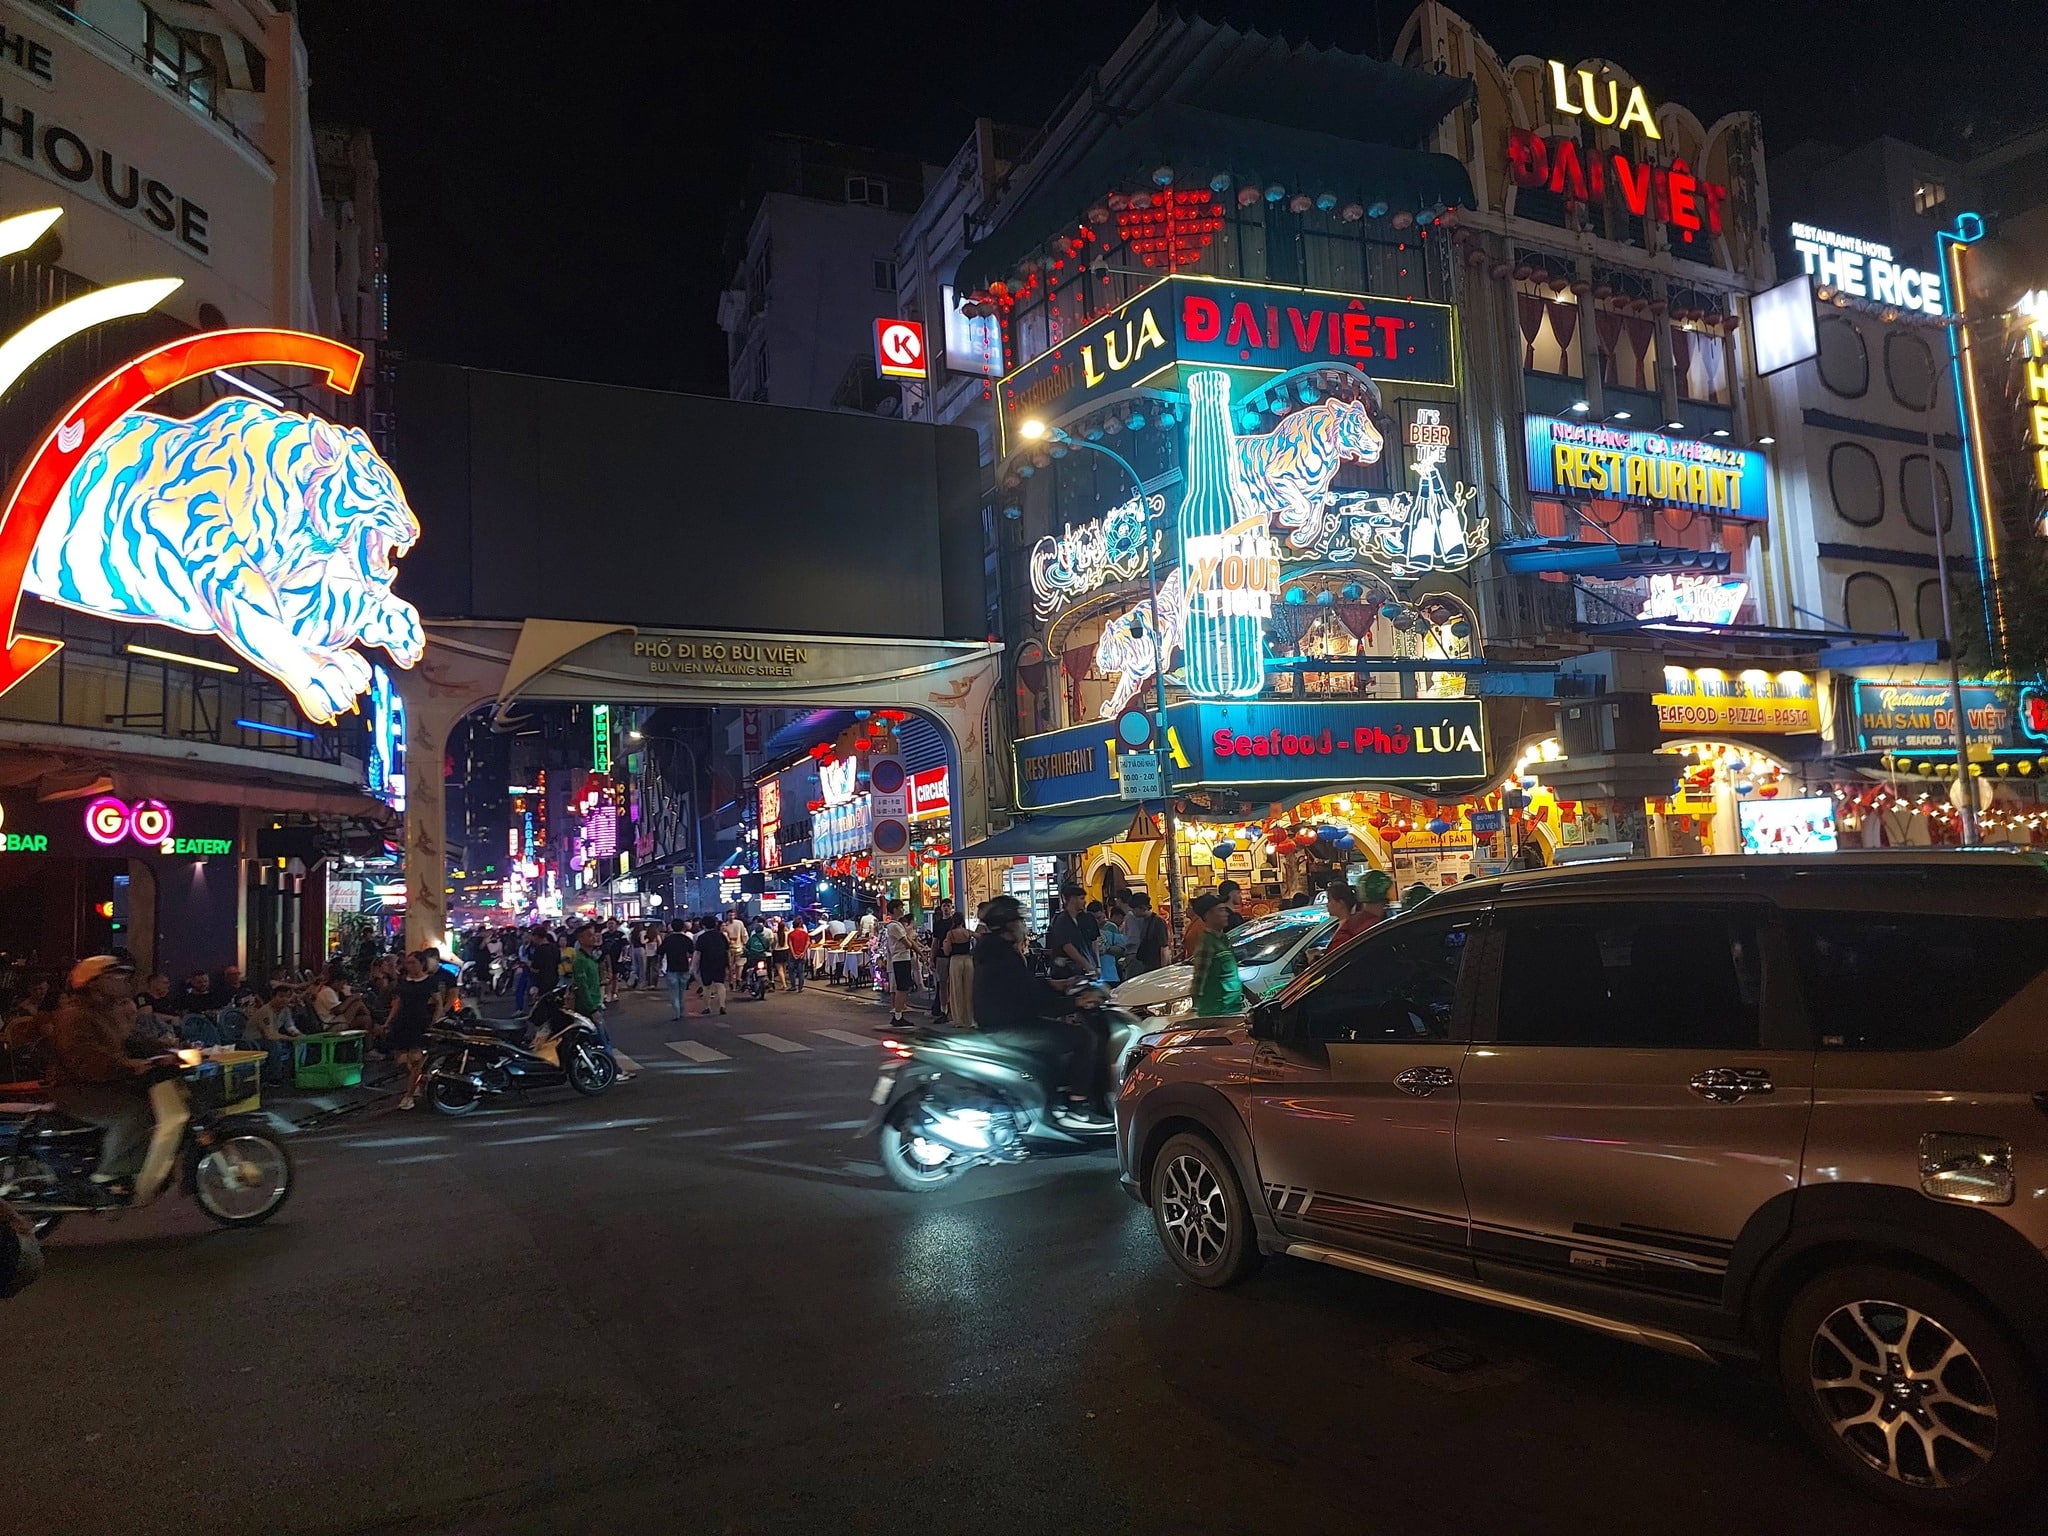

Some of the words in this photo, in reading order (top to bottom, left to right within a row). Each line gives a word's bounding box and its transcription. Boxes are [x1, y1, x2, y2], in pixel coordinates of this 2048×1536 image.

[0, 97, 209, 255] HOUSE
[1614, 154, 1726, 243] VIỆT
[1795, 239, 1866, 297] THE
[1869, 258, 1943, 316] RICE
[1080, 306, 1167, 389] LÚA
[1183, 296, 1280, 361] ĐẠI
[1287, 300, 1405, 372] VIỆT
[1416, 408, 1440, 425] IT'S
[1410, 423, 1450, 445] BEER
[1416, 444, 1447, 463] TIME
[1554, 444, 1744, 510] RESTAURANT
[1199, 555, 1281, 595] YOUR
[634, 638, 671, 658] PHỐ
[678, 643, 696, 659] ĐI
[702, 642, 727, 663] BỘ
[732, 643, 760, 661] BÙI
[766, 645, 808, 666] VIỆN
[650, 662, 670, 672] BUI
[673, 663, 700, 673] VIEN
[704, 664, 756, 675] WALKING
[758, 666, 795, 677] STREET
[1880, 687, 1951, 711] Restaurant
[1728, 706, 1766, 725] PIZZA
[1774, 708, 1810, 726] PASTA
[1967, 703, 2006, 734] VIỆT
[1024, 747, 1095, 781] RESTAURANT
[1105, 725, 1191, 781] LA
[1213, 729, 1332, 758] Seafood
[1354, 724, 1411, 755] Phở
[1413, 718, 1482, 753] LÚA
[1871, 735, 1898, 746] STEAK
[1906, 735, 1942, 746] SEAFOOD
[916, 780, 944, 803] CIRCLE
